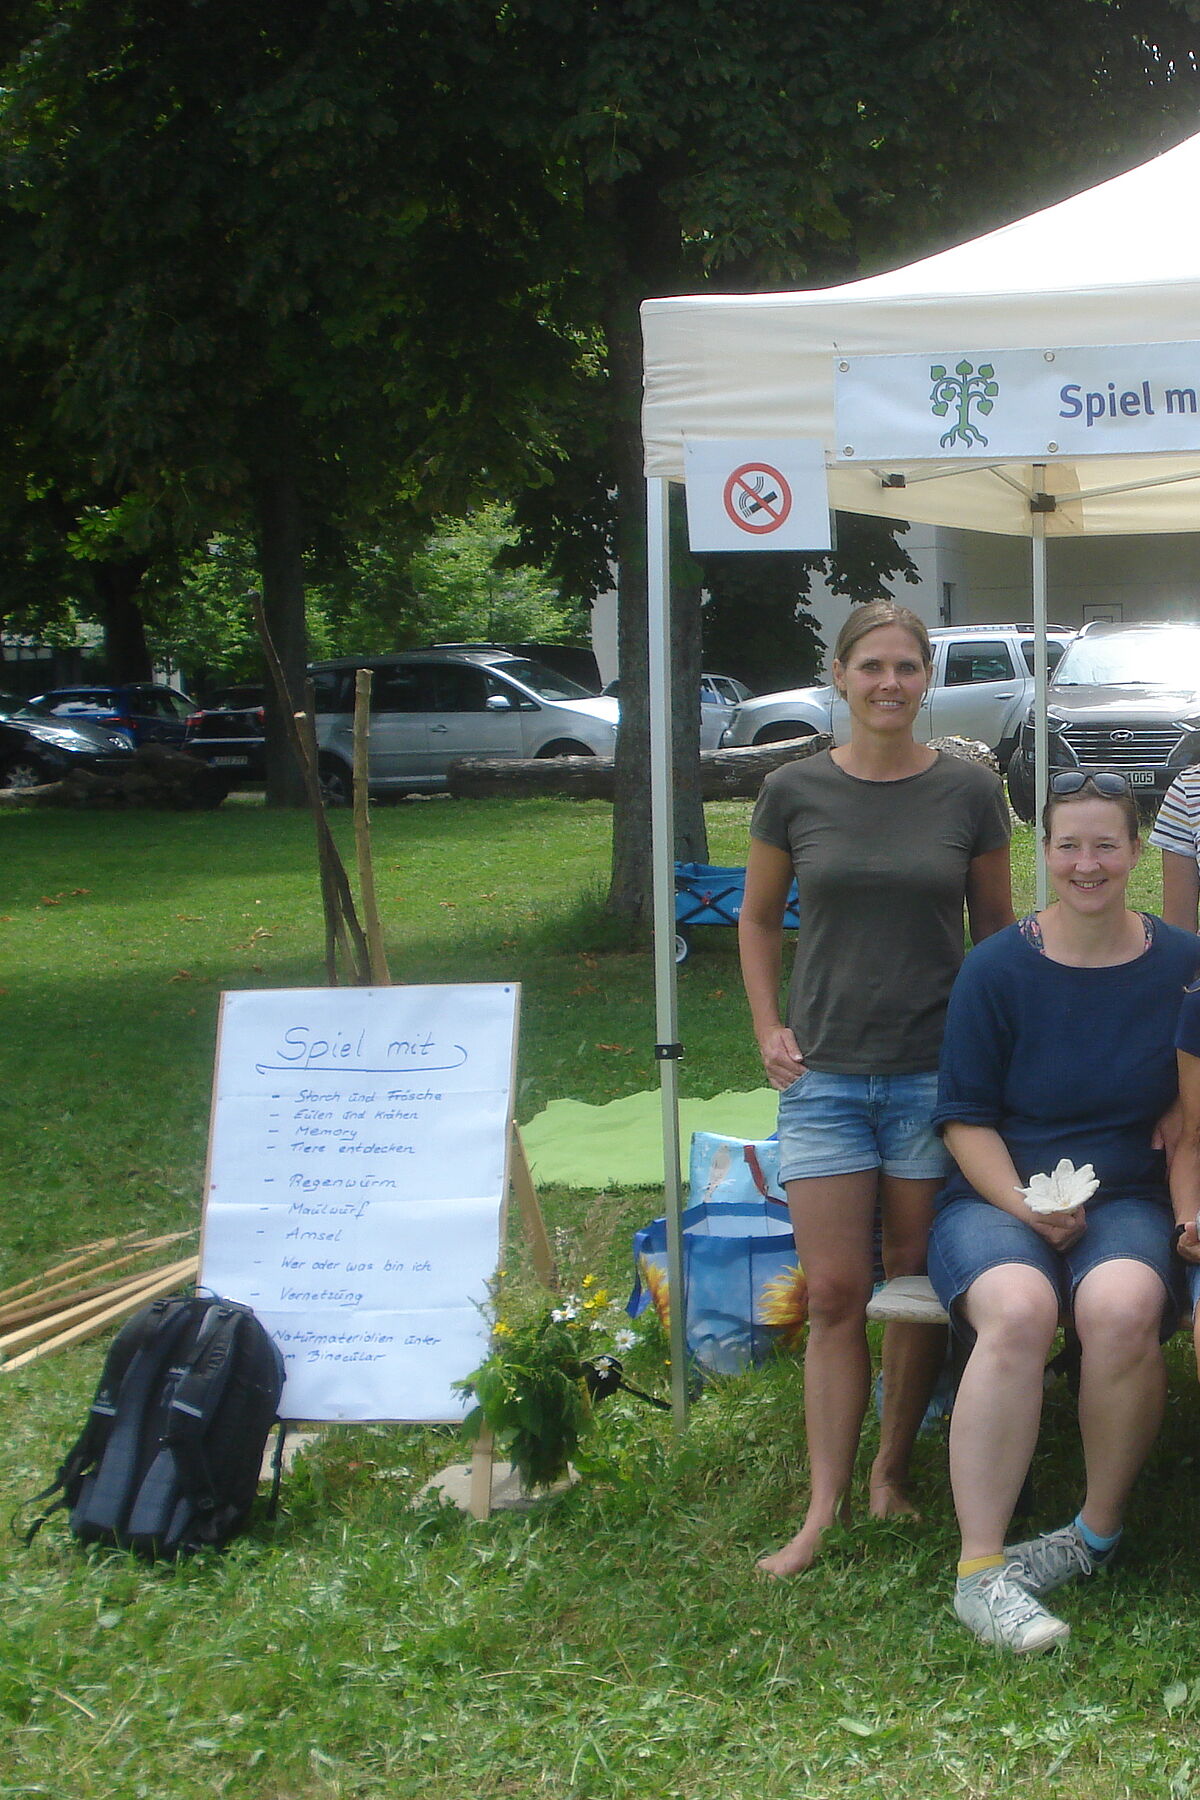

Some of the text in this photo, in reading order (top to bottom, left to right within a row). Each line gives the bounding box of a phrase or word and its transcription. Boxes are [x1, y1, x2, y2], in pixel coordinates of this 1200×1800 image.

[1059, 380, 1155, 428] Spiel
[277, 1026, 436, 1071] Spiel mit
[295, 1126, 358, 1141] Memory
[338, 1143, 416, 1154] entdecken
[285, 1228, 343, 1242] Amsel
[280, 1256, 432, 1272] Wer oder was bin ich
